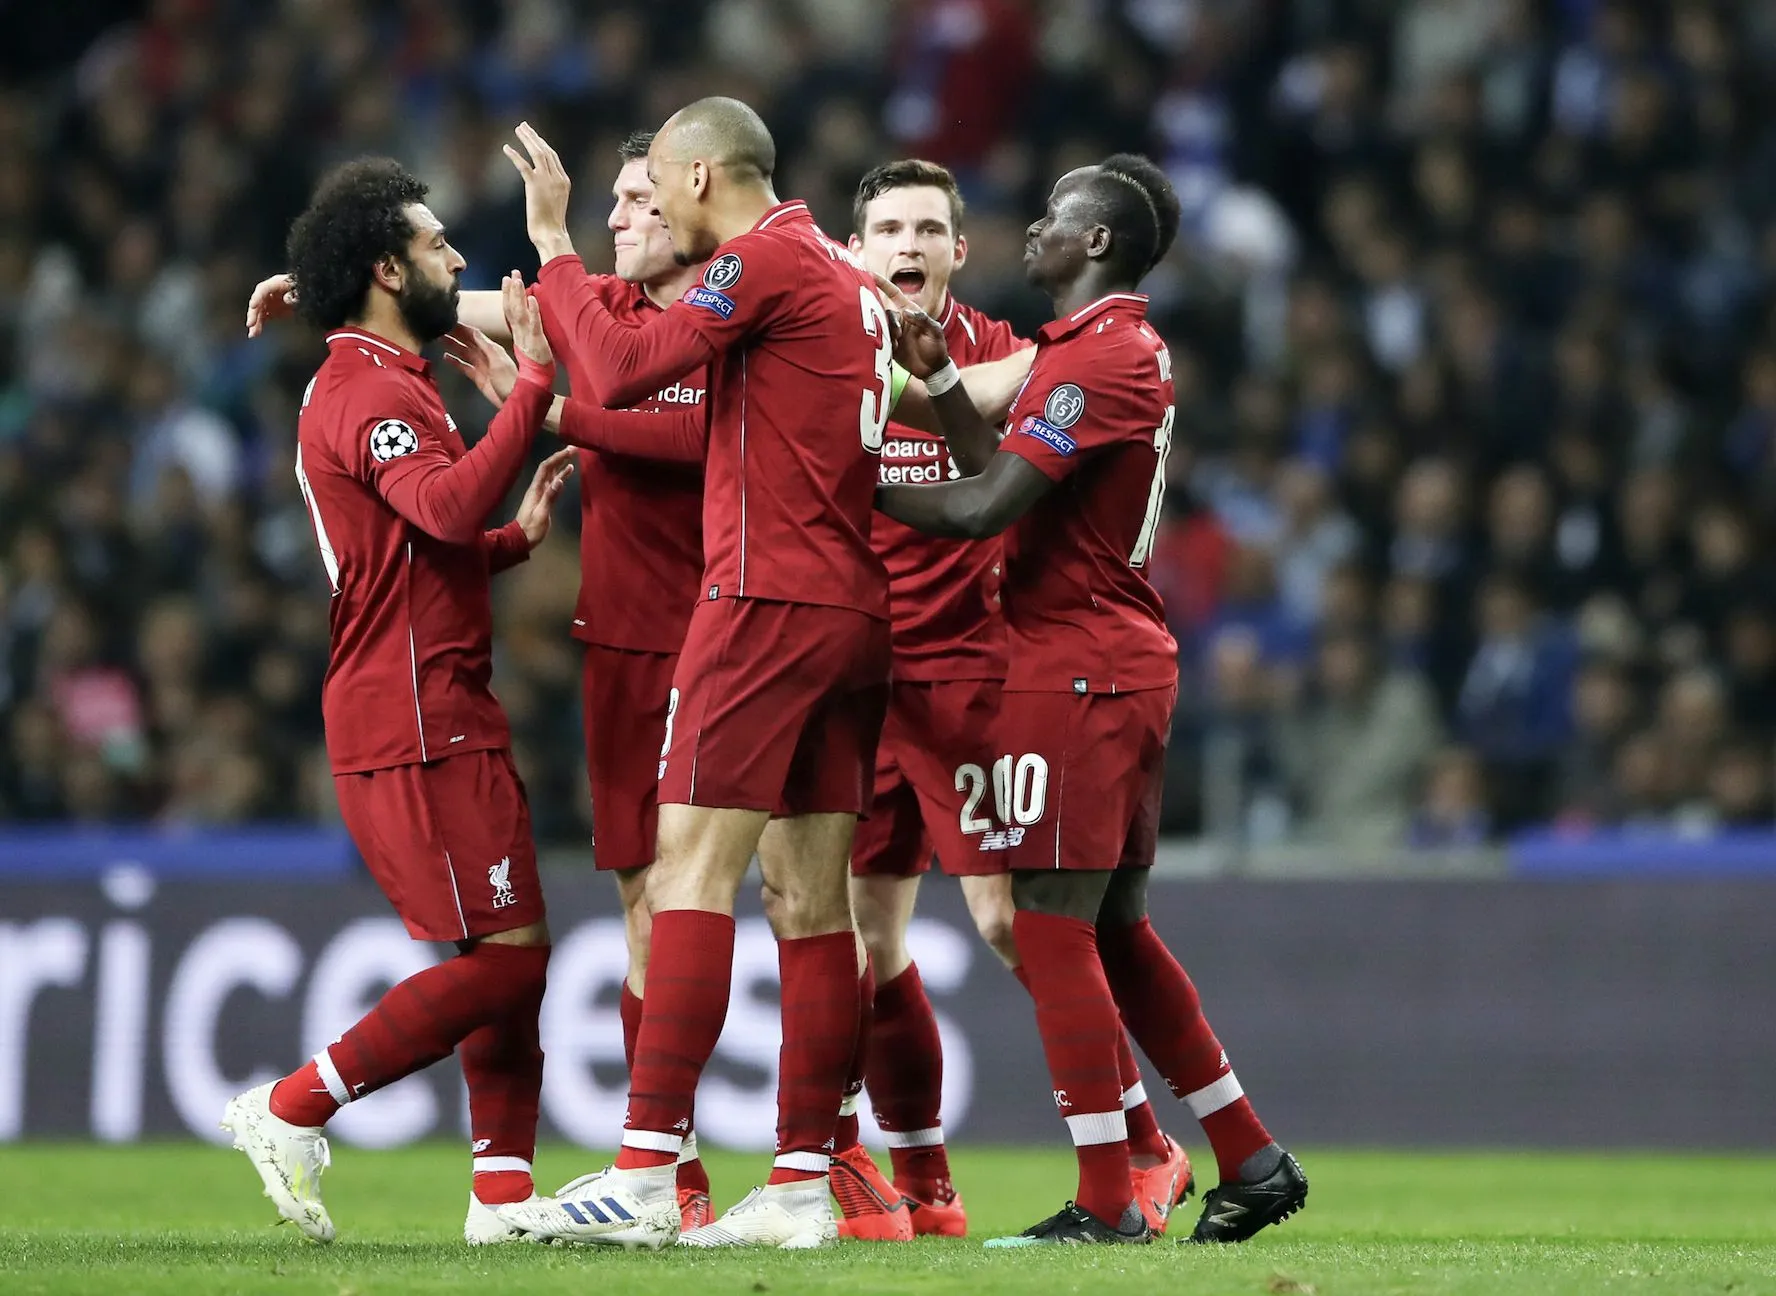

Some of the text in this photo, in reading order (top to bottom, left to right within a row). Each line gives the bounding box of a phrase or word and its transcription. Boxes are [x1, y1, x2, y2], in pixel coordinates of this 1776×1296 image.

[694, 292, 734, 315] RESPECT
[859, 284, 893, 453] 3
[1056, 404, 1068, 416] 5
[1032, 423, 1075, 453] RESPECT
[1003, 752, 1049, 826] 10
